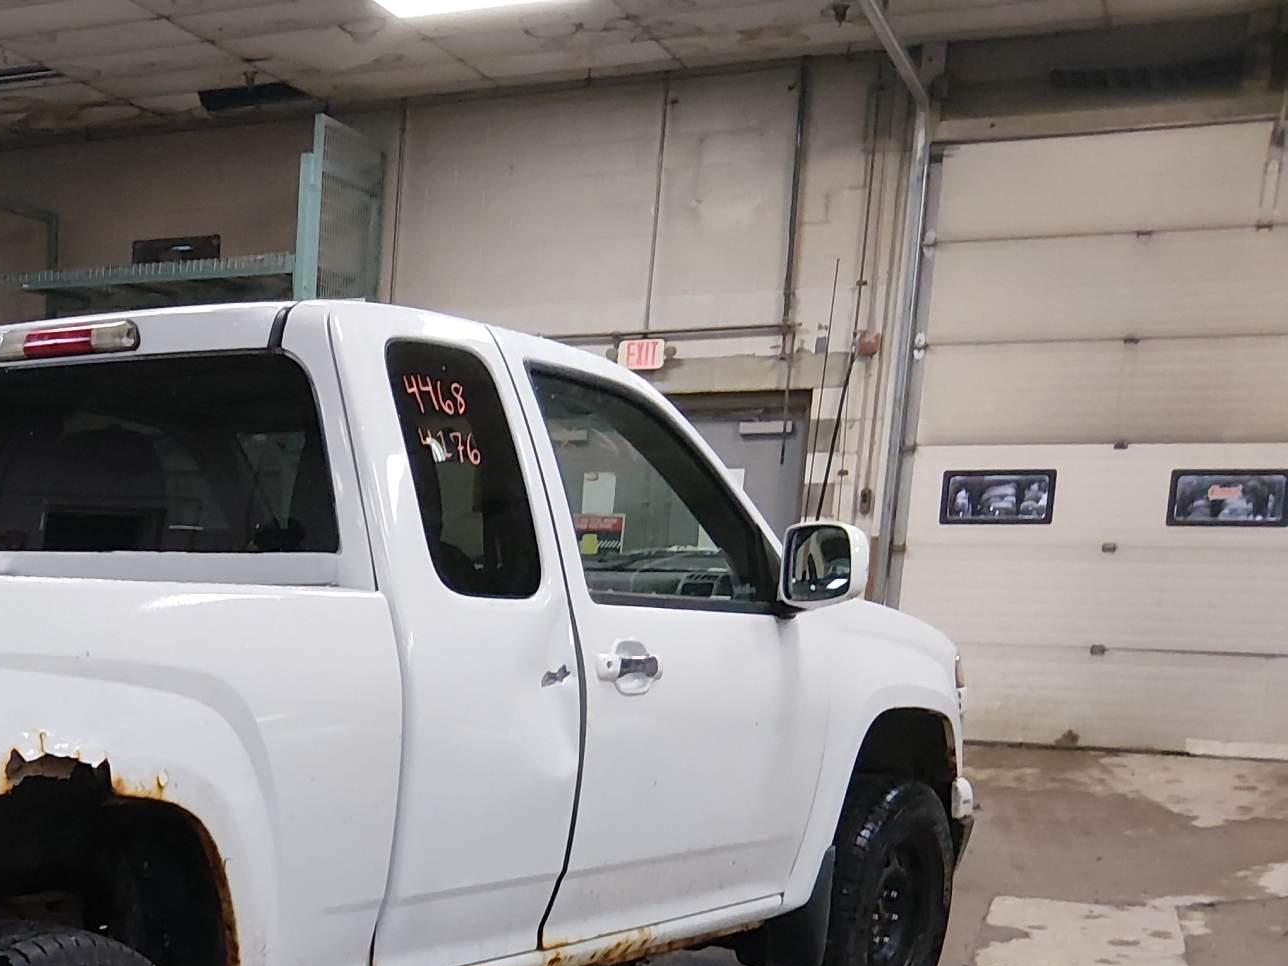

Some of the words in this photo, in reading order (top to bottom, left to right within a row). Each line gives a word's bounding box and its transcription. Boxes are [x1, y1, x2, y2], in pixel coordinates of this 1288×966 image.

[626, 341, 659, 367] EXIT
[403, 374, 466, 416] 4468
[418, 427, 481, 465] 4176
